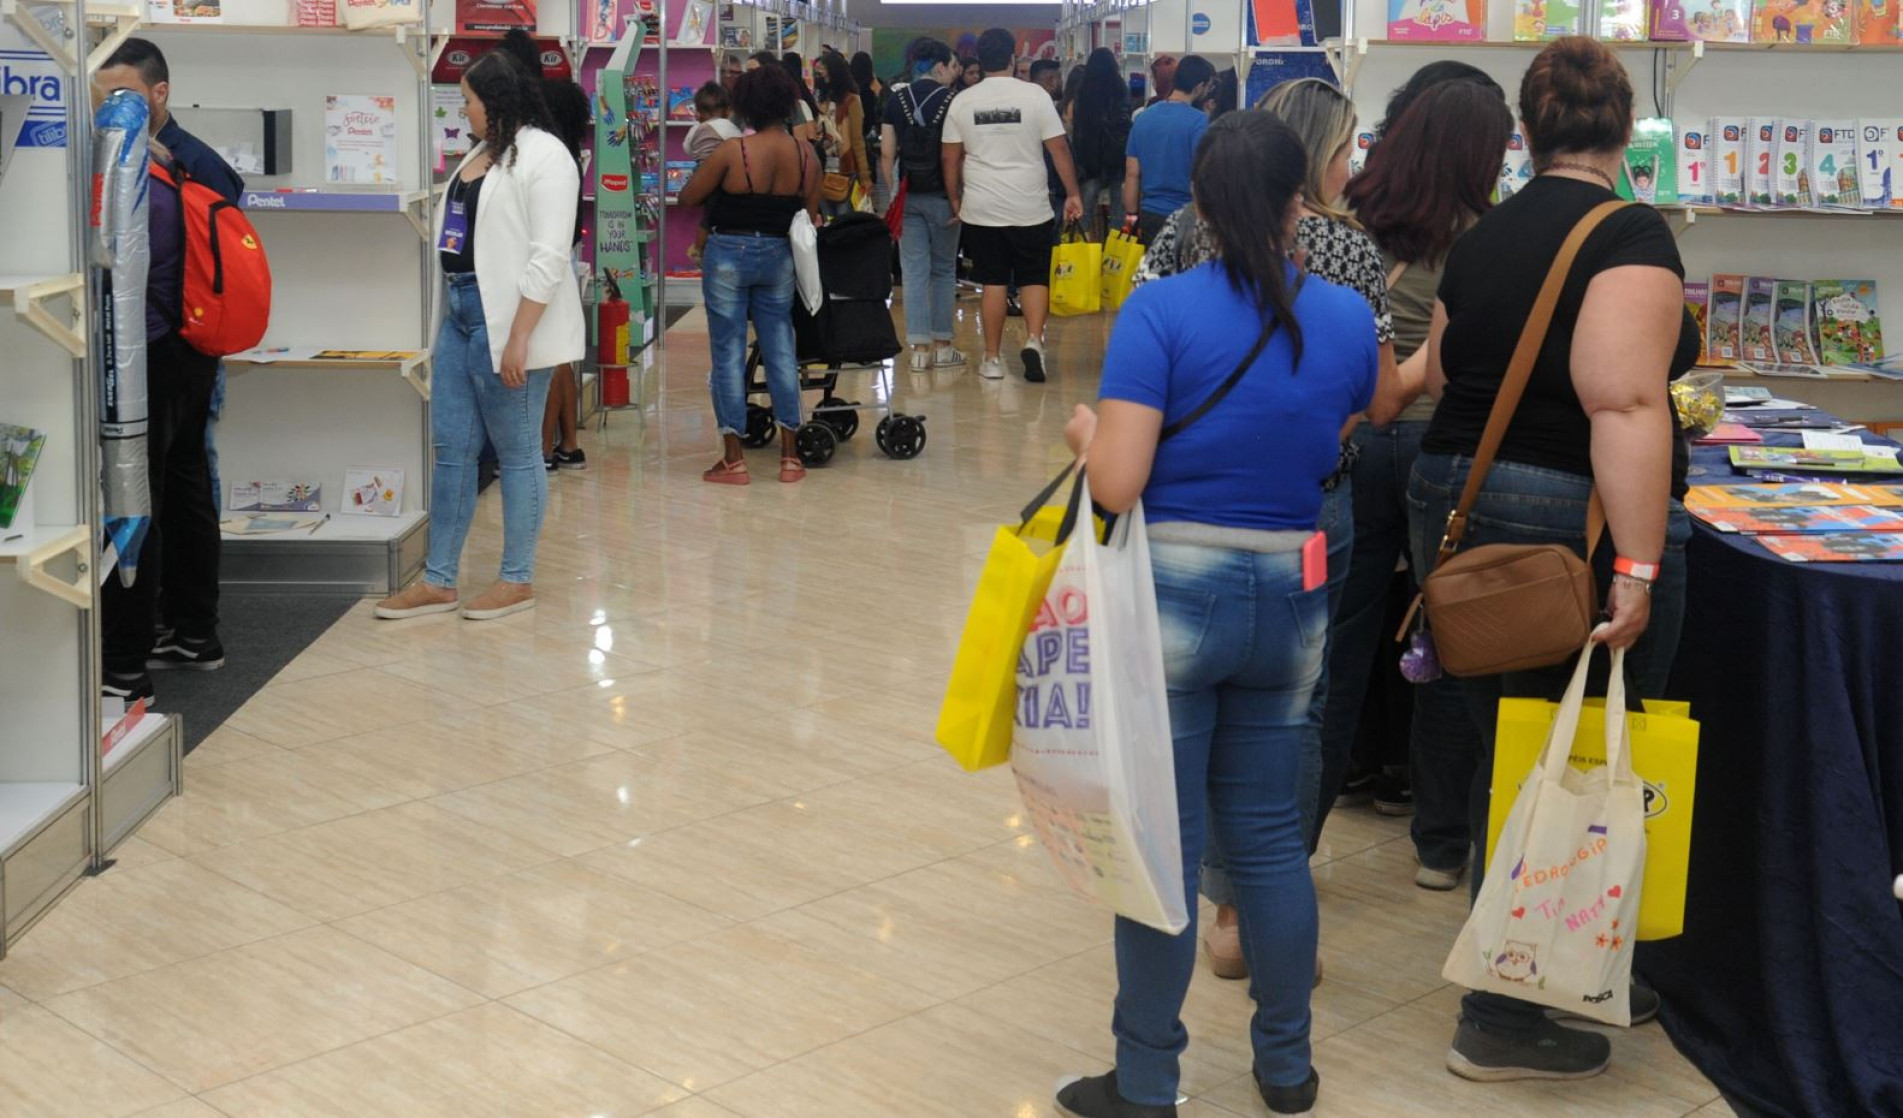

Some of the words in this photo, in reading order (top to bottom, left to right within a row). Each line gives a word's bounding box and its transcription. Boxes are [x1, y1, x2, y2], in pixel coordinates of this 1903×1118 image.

[1672, 9, 1679, 20] 3
[0, 66, 60, 101] bra
[1724, 150, 1737, 175] 1
[1758, 152, 1770, 175] 2
[1783, 152, 1797, 175] 3
[1819, 153, 1837, 176] 4
[247, 194, 286, 208] Pentel
[607, 229, 626, 239] YOUR
